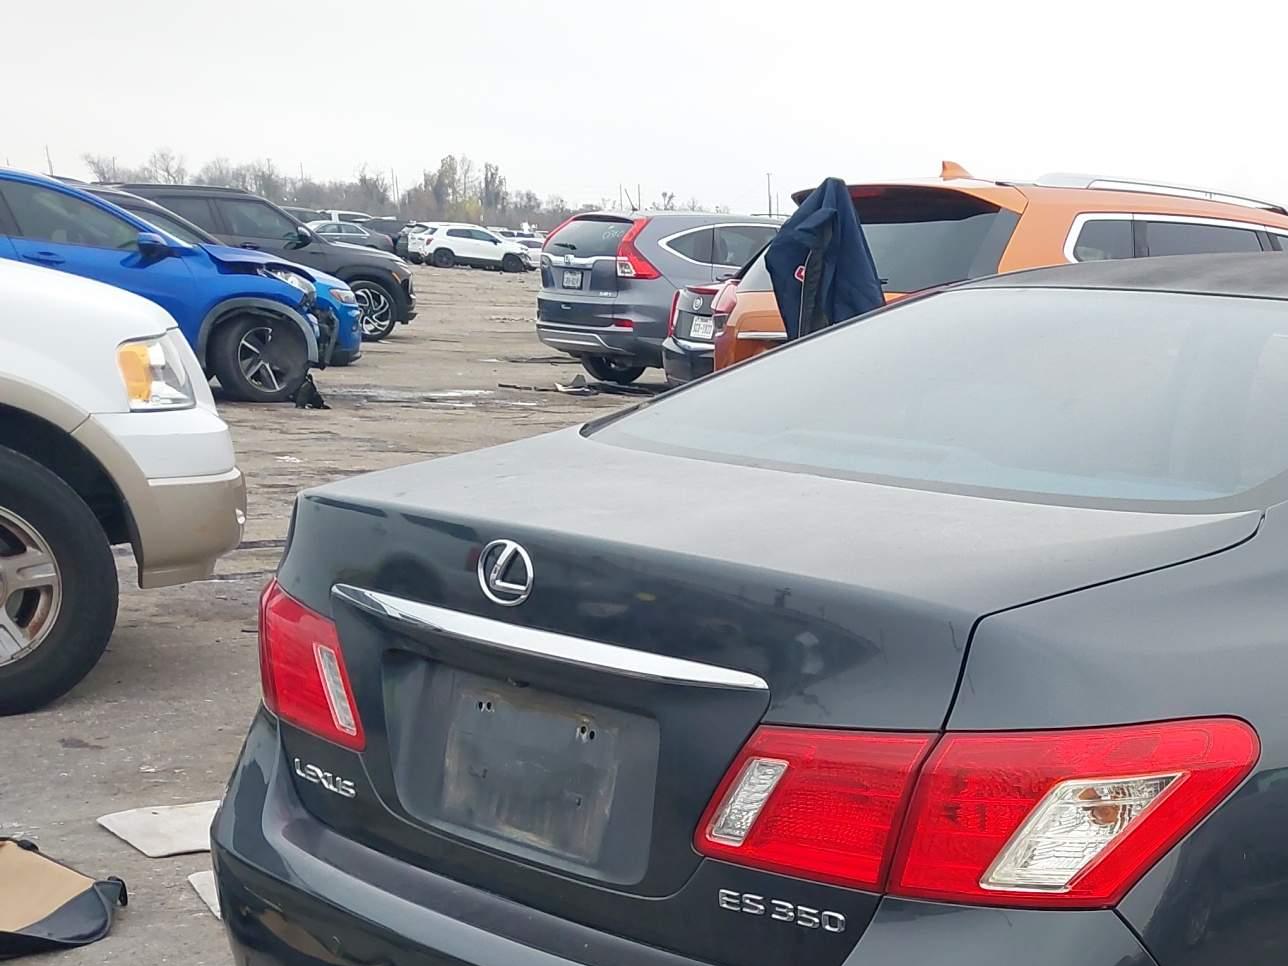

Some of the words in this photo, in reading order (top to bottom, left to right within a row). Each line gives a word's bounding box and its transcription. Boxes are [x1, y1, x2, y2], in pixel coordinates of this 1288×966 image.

[294, 757, 357, 799] LEXUS
[718, 888, 766, 916] ES
[770, 899, 847, 934] 350
